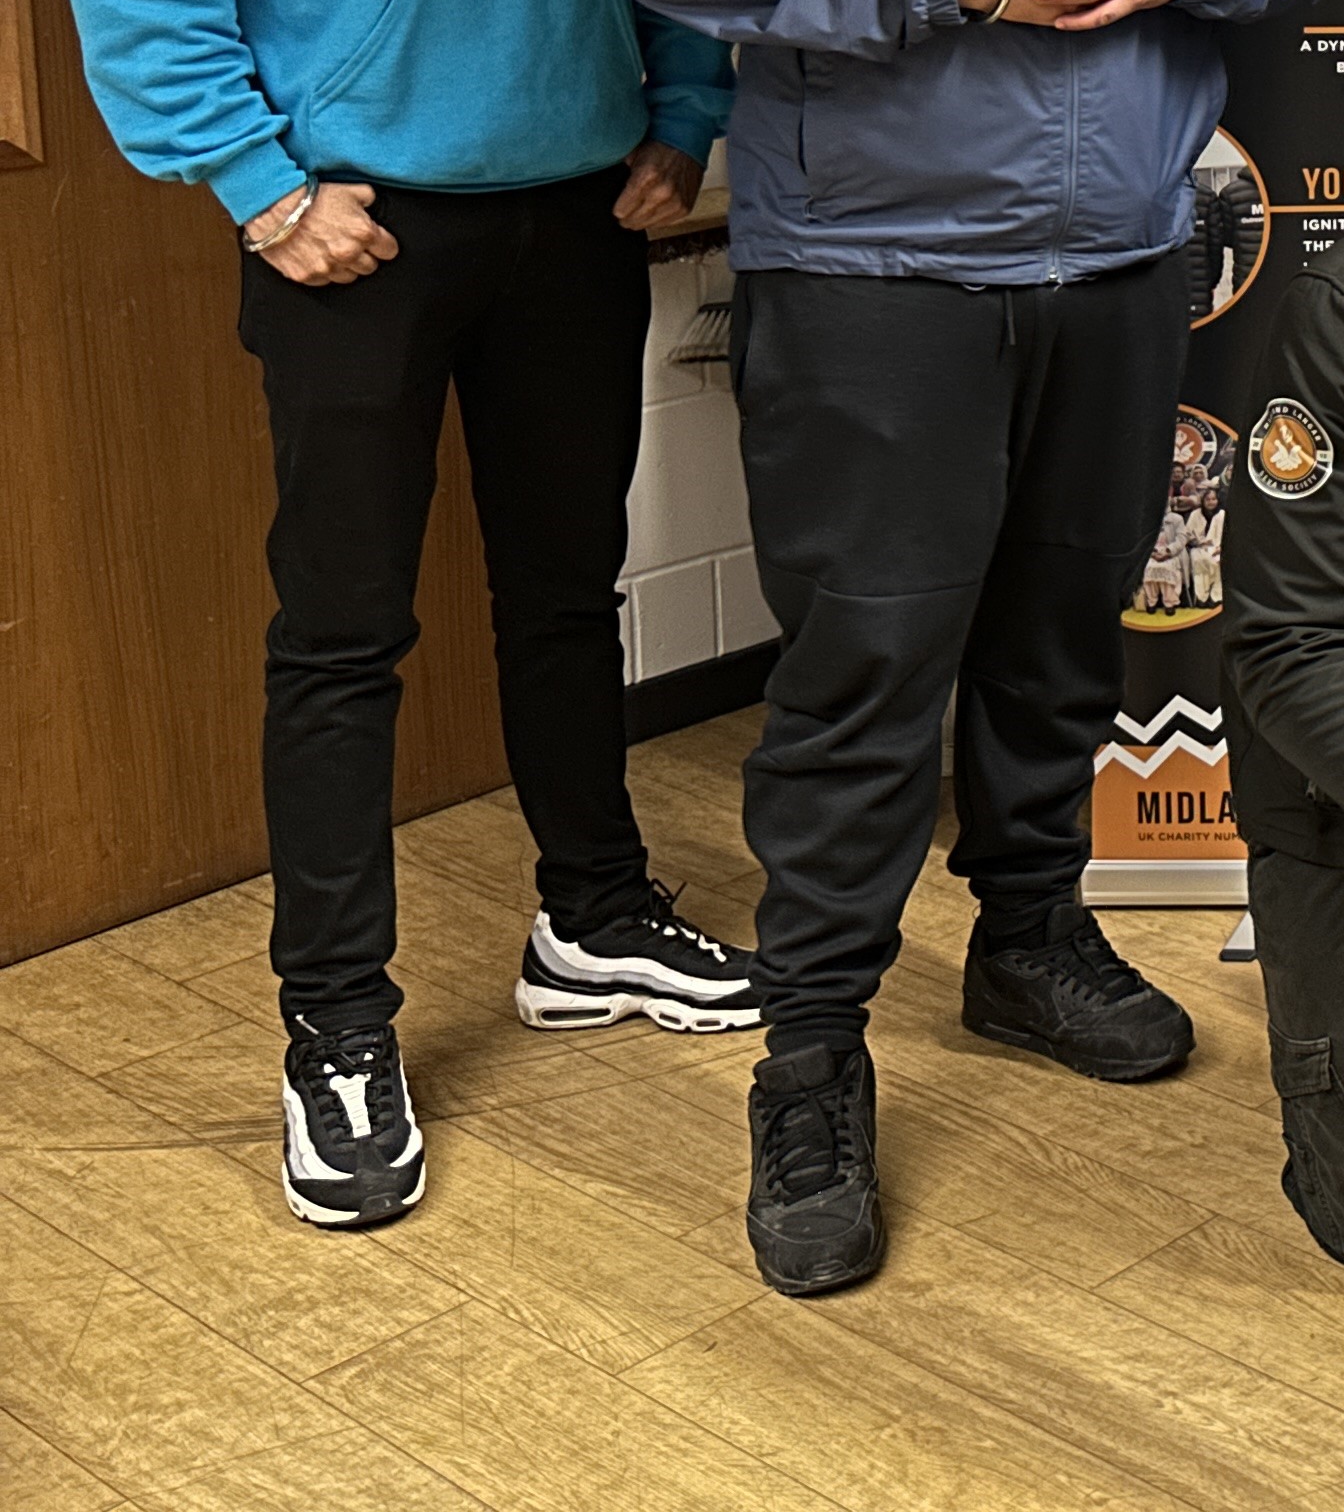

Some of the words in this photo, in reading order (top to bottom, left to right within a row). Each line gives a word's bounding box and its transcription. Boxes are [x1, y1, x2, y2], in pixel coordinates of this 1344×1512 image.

[1300, 40, 1312, 52] A
[1138, 832, 1154, 841] UK
[1158, 832, 1210, 842] CHARITY
